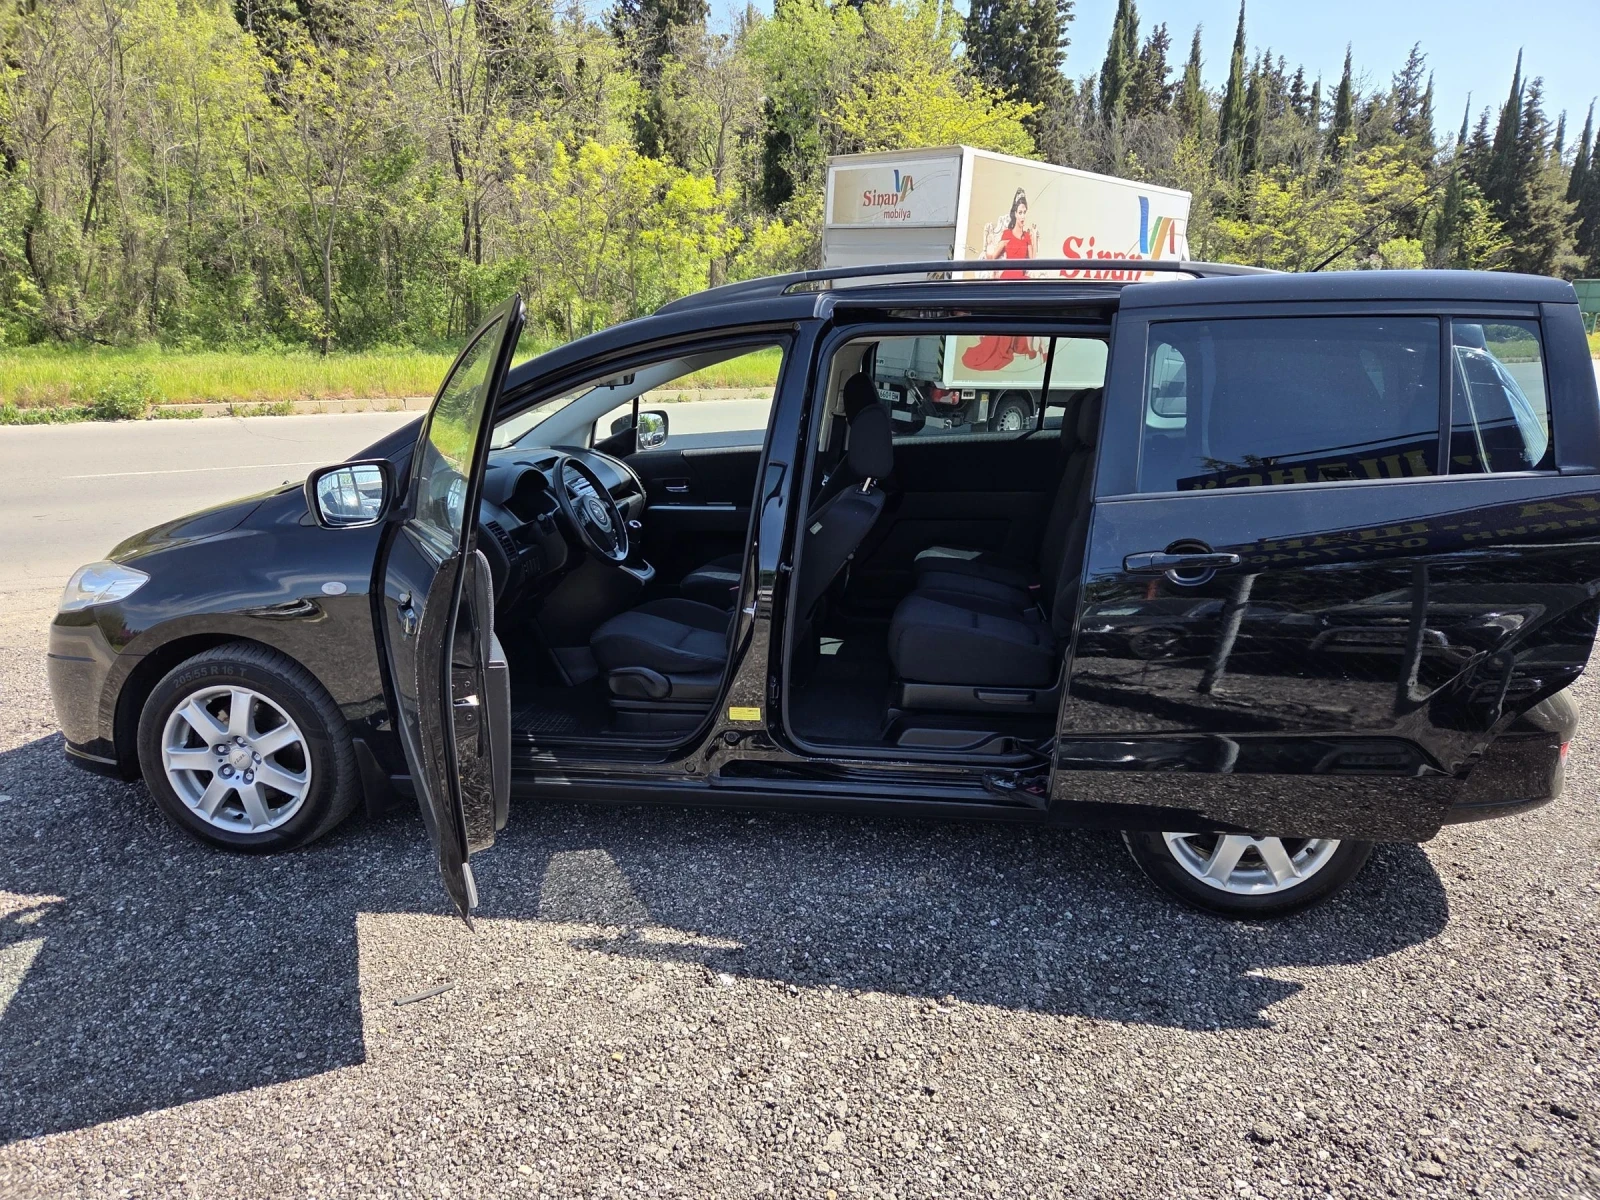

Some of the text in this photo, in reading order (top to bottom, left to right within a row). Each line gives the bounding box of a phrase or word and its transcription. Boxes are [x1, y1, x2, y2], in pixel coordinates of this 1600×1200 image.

[862, 189, 898, 209] Sinan
[883, 208, 912, 221] mobilya
[173, 668, 208, 689] 205/55
[210, 665, 219, 675] R
[222, 665, 234, 675] 16
